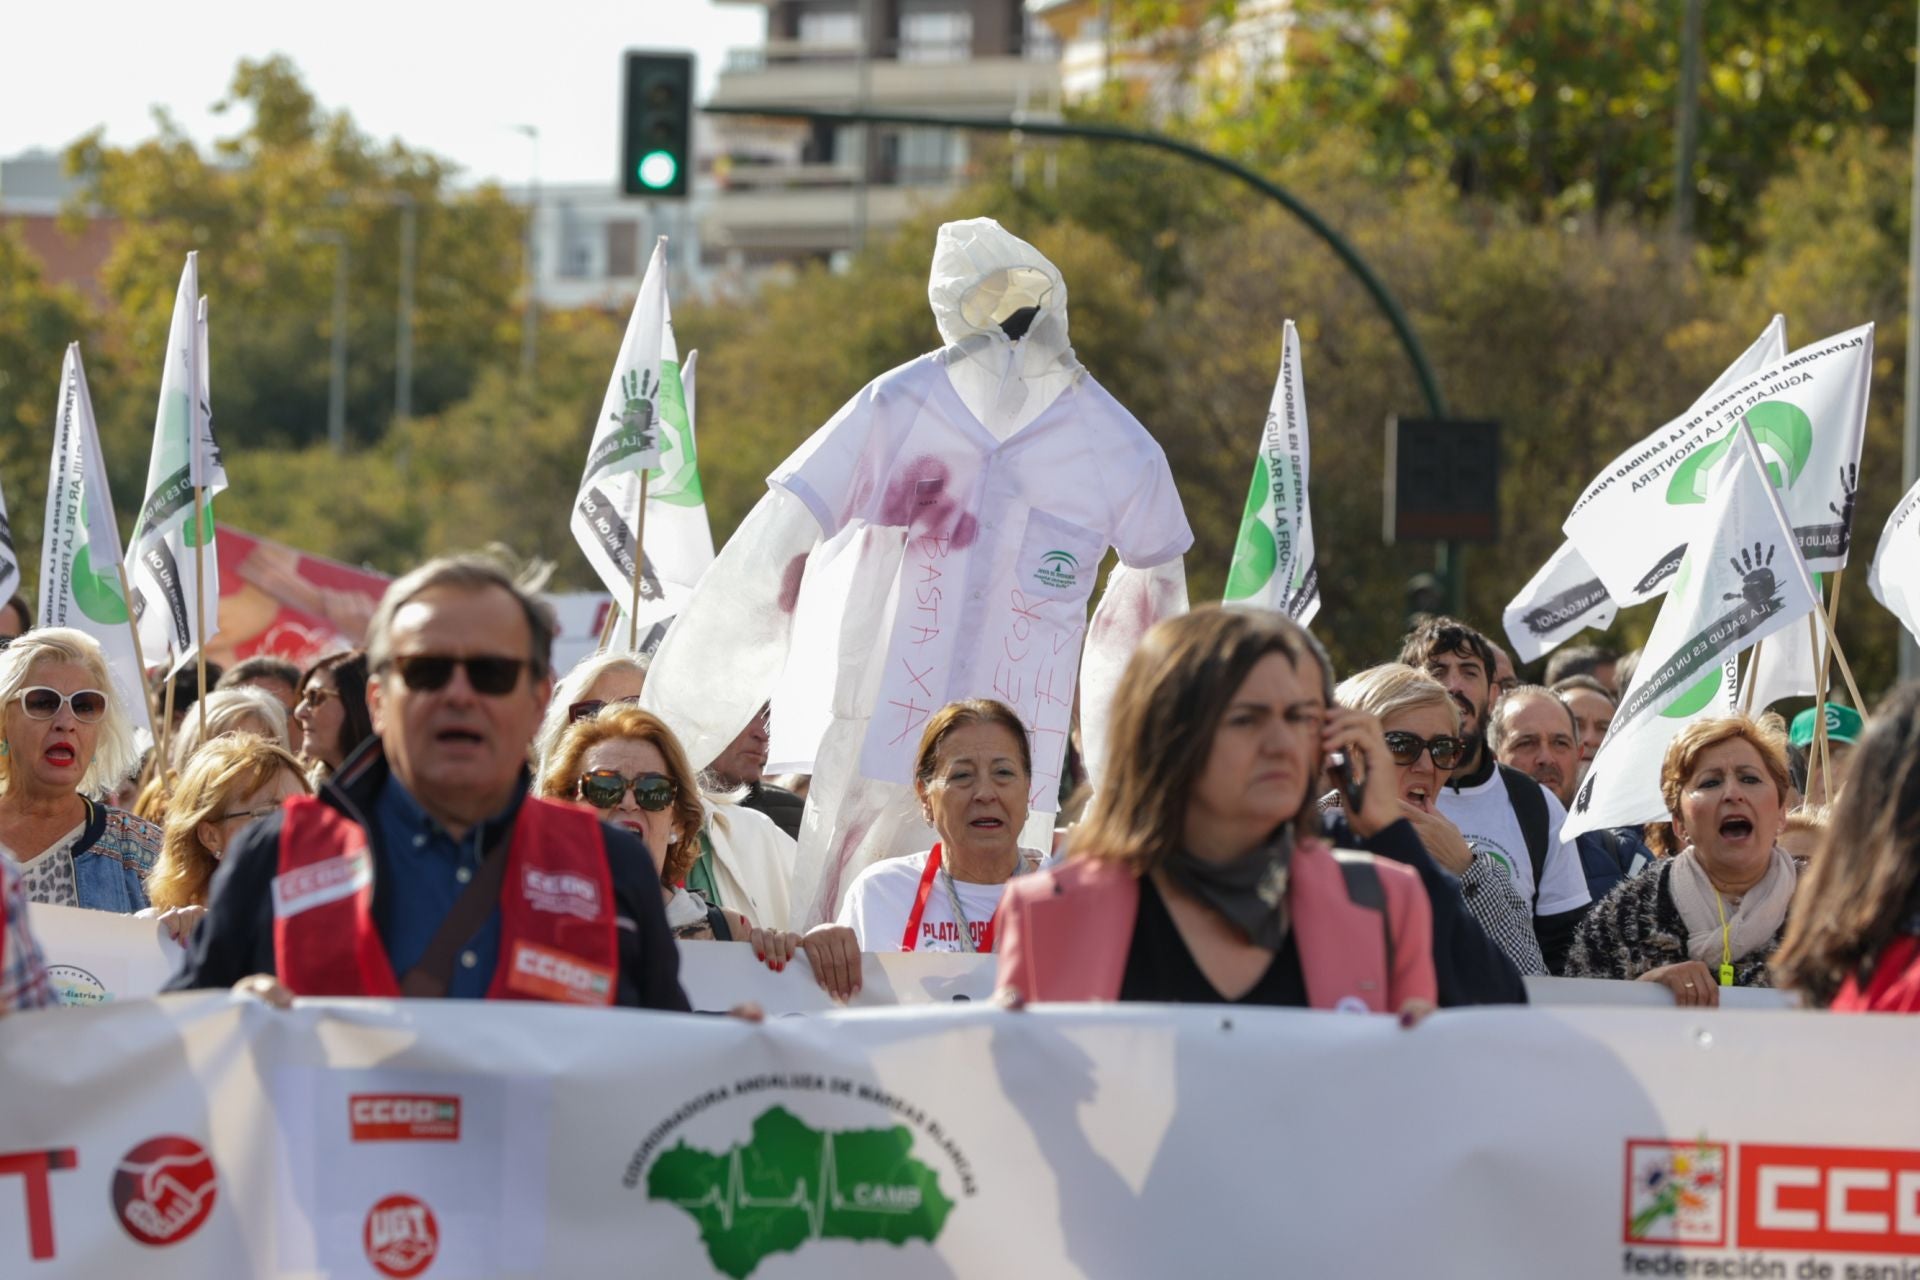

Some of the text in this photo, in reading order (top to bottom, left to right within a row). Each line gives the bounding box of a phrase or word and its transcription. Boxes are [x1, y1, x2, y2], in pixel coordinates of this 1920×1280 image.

[1288, 434, 1299, 451] EN
[1272, 483, 1286, 504] DE
[1275, 508, 1289, 528] LA
[594, 517, 611, 535] NO
[606, 533, 622, 551] UN
[147, 550, 164, 569] NO
[159, 568, 173, 588] UN
[910, 532, 949, 645] BASTA
[354, 1100, 436, 1124] CCOO
[735, 1072, 825, 1095] ANDALUZA
[829, 1076, 853, 1095] DE
[857, 1084, 926, 1123] MAREAS
[927, 1120, 978, 1197] BLANCAS
[371, 1204, 428, 1247] UGT
[1623, 1251, 1787, 1279] federación
[1796, 1257, 1834, 1280] de
